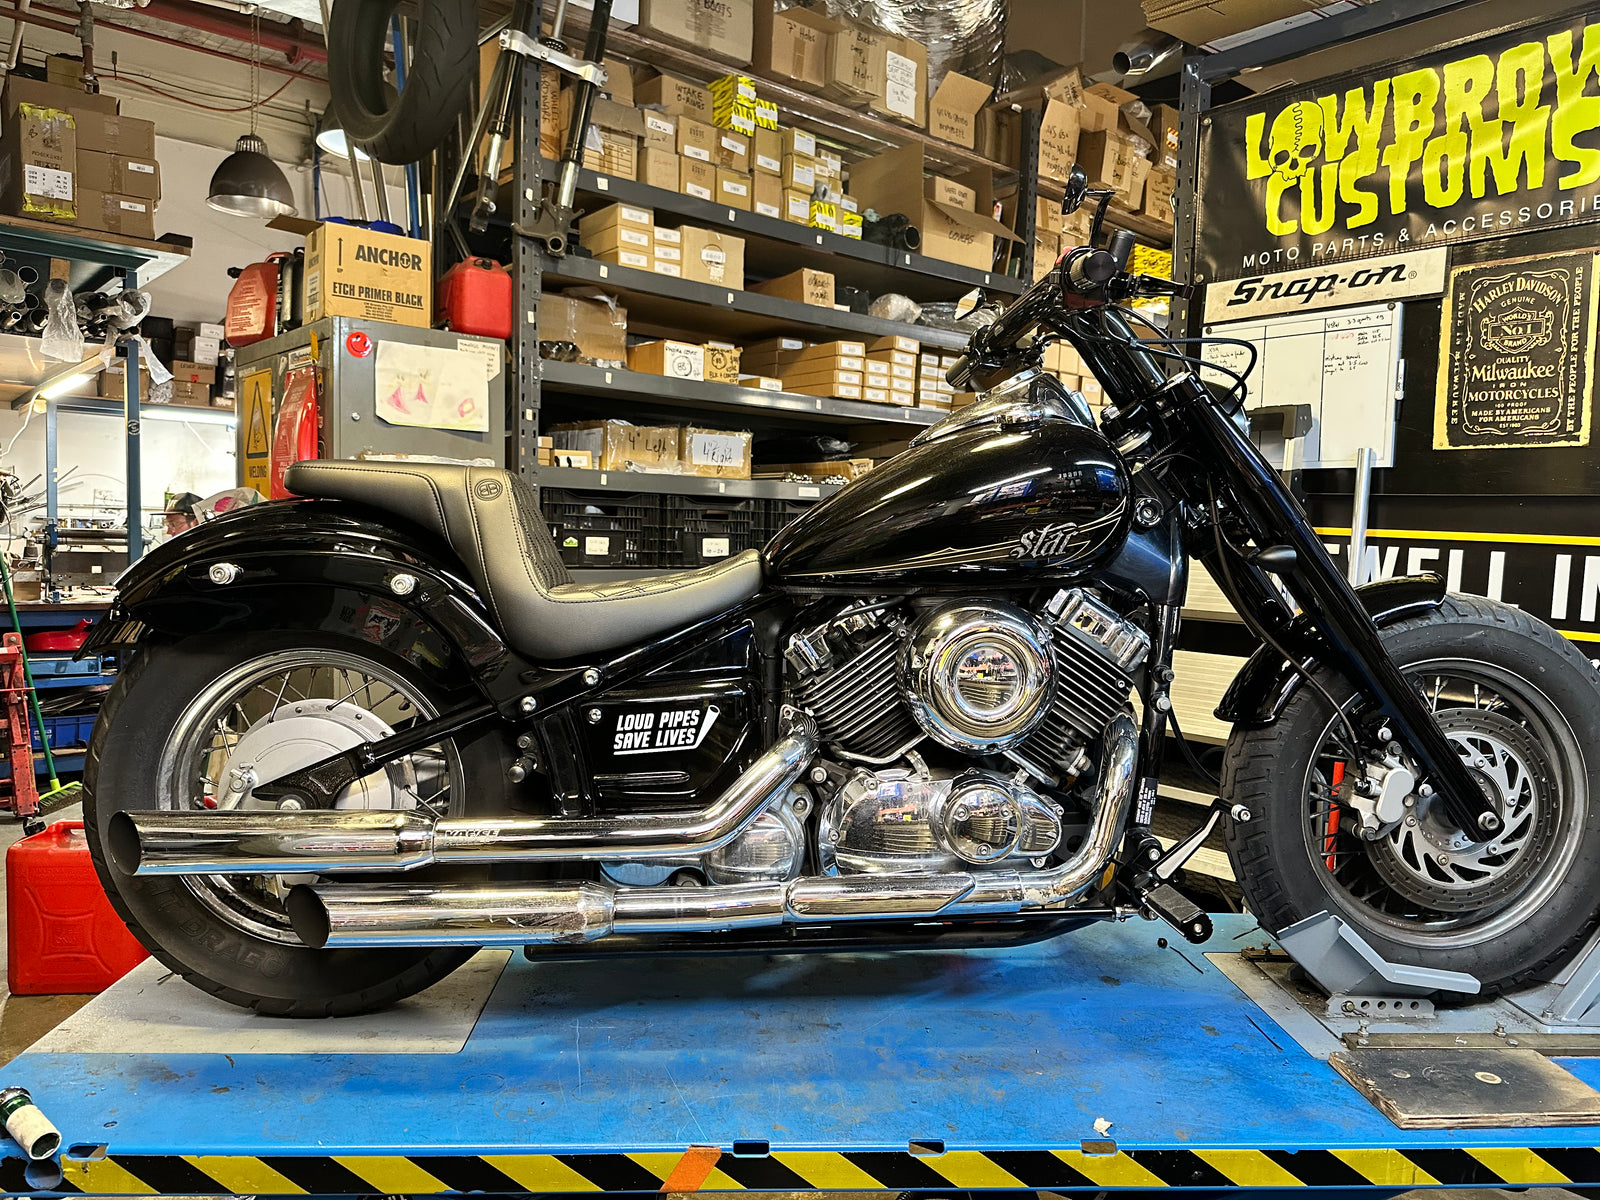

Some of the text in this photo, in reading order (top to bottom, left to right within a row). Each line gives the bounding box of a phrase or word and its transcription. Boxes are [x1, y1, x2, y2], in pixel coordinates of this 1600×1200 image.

[675, 83, 703, 99] INTAKE
[1266, 96, 1600, 236] CUSTOMS
[355, 244, 422, 272] ANCHOR
[1243, 247, 1300, 268] MOTO
[1312, 233, 1384, 256] PARTS
[1399, 228, 1410, 243] &
[332, 282, 423, 307] ETCH PRIMER BLACK
[1473, 277, 1563, 313] HARLEY DAVIDSON
[1500, 296, 1536, 307] GENUINE
[1457, 292, 1466, 327] MADE
[1455, 332, 1462, 345] IN
[1503, 339, 1527, 348] BRAND
[1566, 267, 1583, 432] BY THE PEOPLE FOR THE PEOPLE
[1496, 355, 1530, 364] QUALITY
[1471, 360, 1556, 382] Milwaukee
[1468, 387, 1559, 402] MOTORCYCLES
[1494, 414, 1540, 422] AMERICANS
[1505, 407, 1551, 415] AMERICANS
[616, 710, 700, 732] LOUD PIPES
[613, 728, 696, 750] SAVE LIVES
